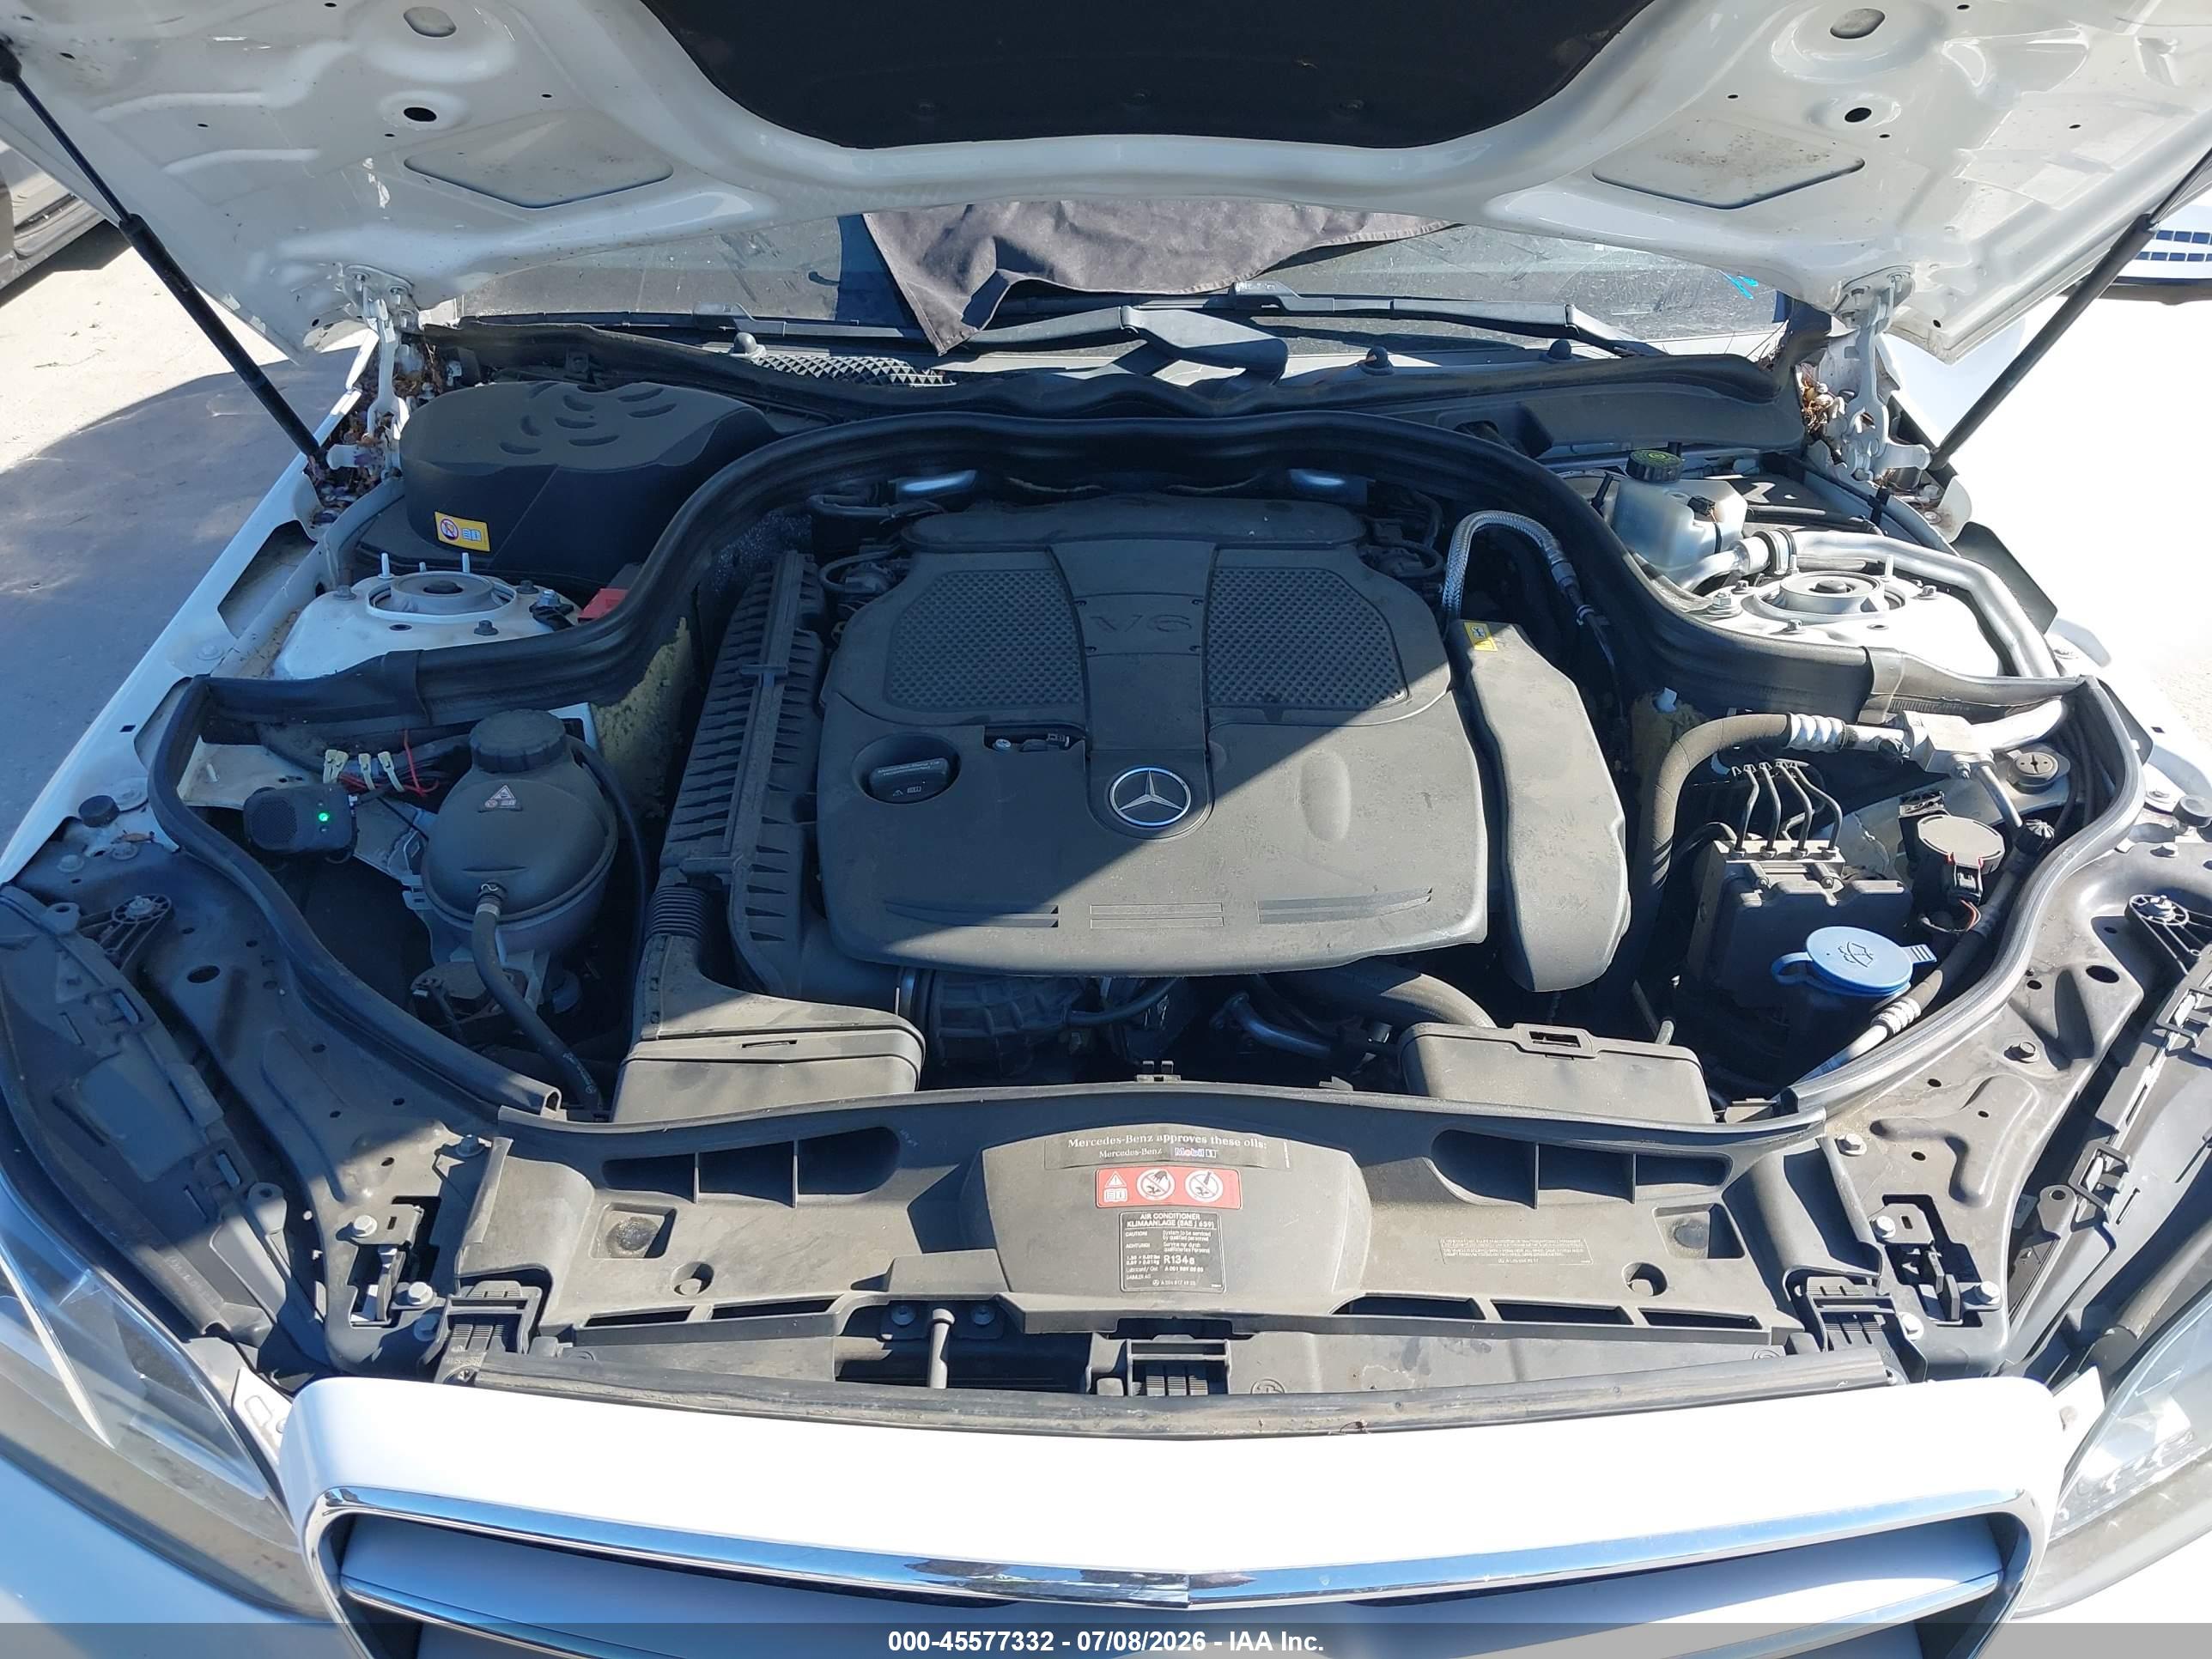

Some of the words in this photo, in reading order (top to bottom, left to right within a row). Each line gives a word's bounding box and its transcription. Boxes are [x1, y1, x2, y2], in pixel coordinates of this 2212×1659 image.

[1067, 1134, 1154, 1148] Mercedes-Benz
[1156, 1134, 1207, 1146] approves
[1211, 1135, 1241, 1146] these
[1243, 1139, 1267, 1150] oils:
[1098, 1147, 1163, 1158] Mercedes-Benz
[1174, 1146, 1206, 1158] Mobil
